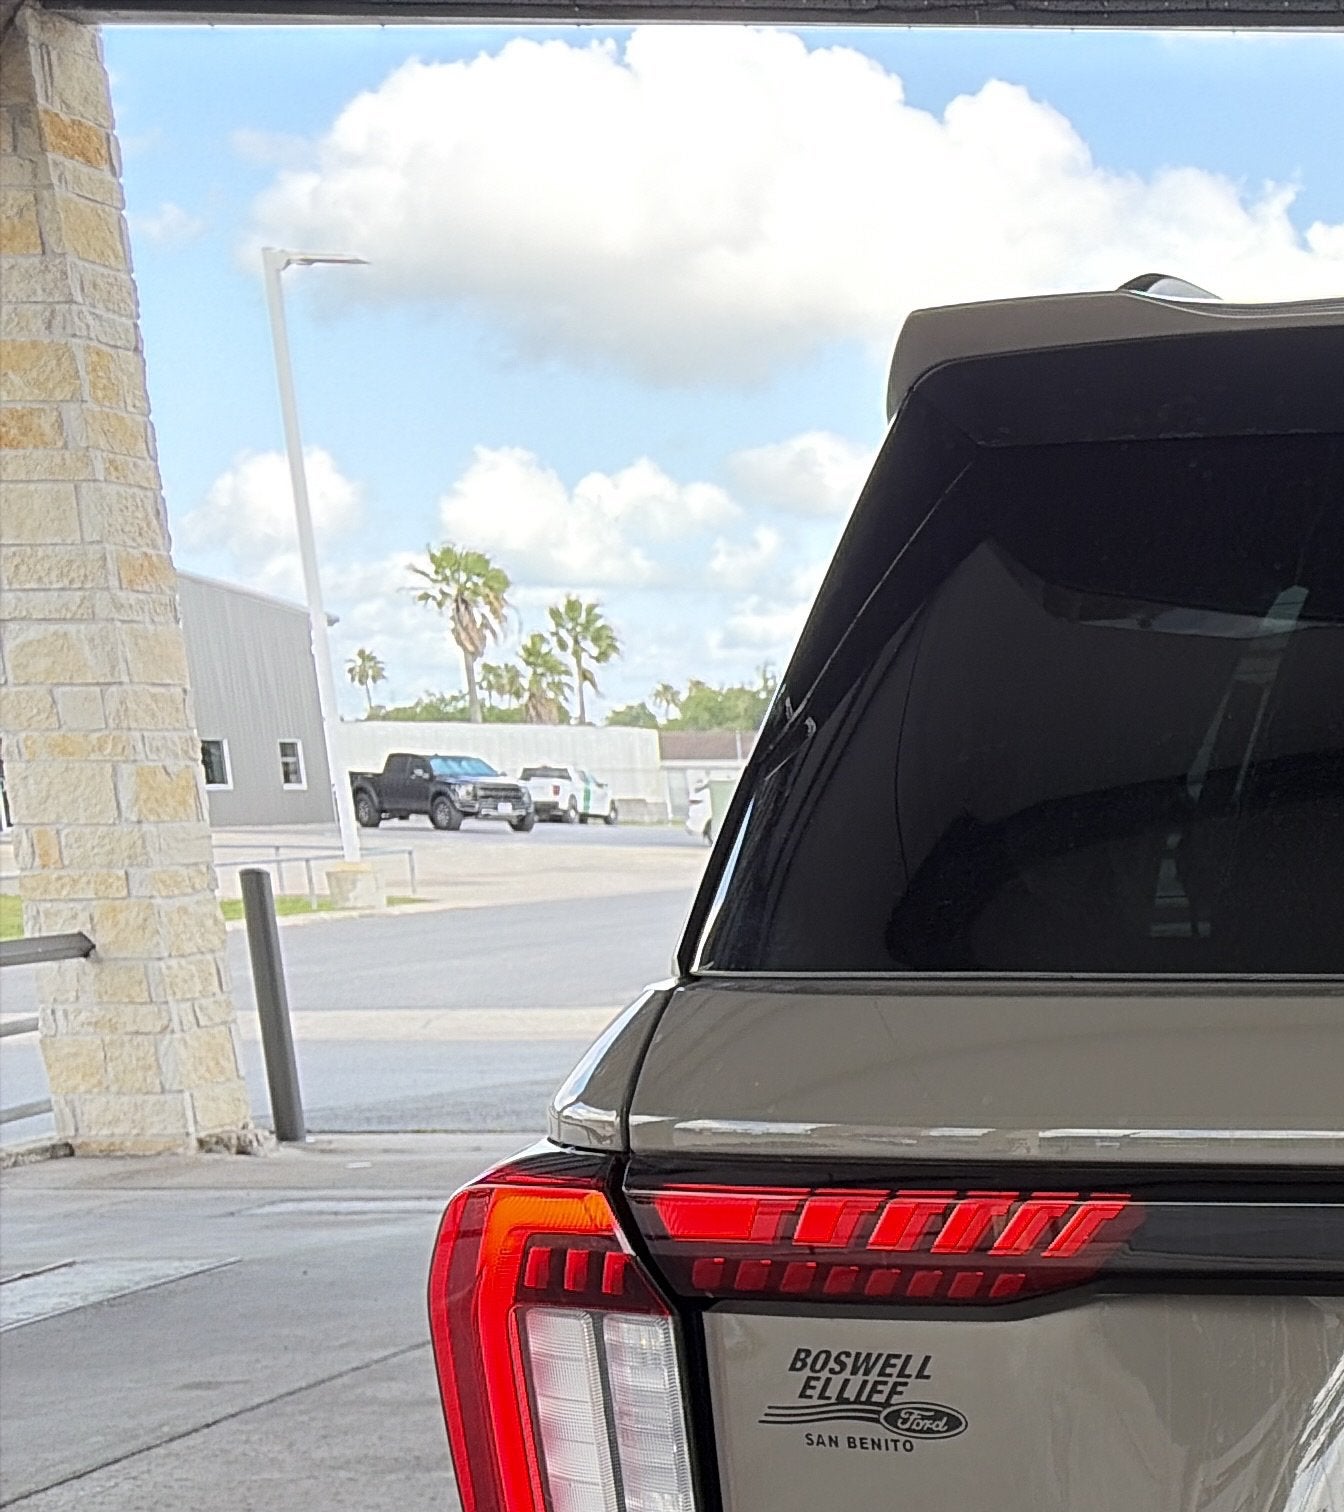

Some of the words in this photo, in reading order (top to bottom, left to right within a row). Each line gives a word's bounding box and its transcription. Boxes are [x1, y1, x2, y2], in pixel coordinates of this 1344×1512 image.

[788, 1347, 932, 1380] BOSWELL
[798, 1375, 910, 1405] ELLIFF
[896, 1408, 949, 1433] Ford
[804, 1433, 840, 1449] SAN
[847, 1435, 915, 1453] BENITO
